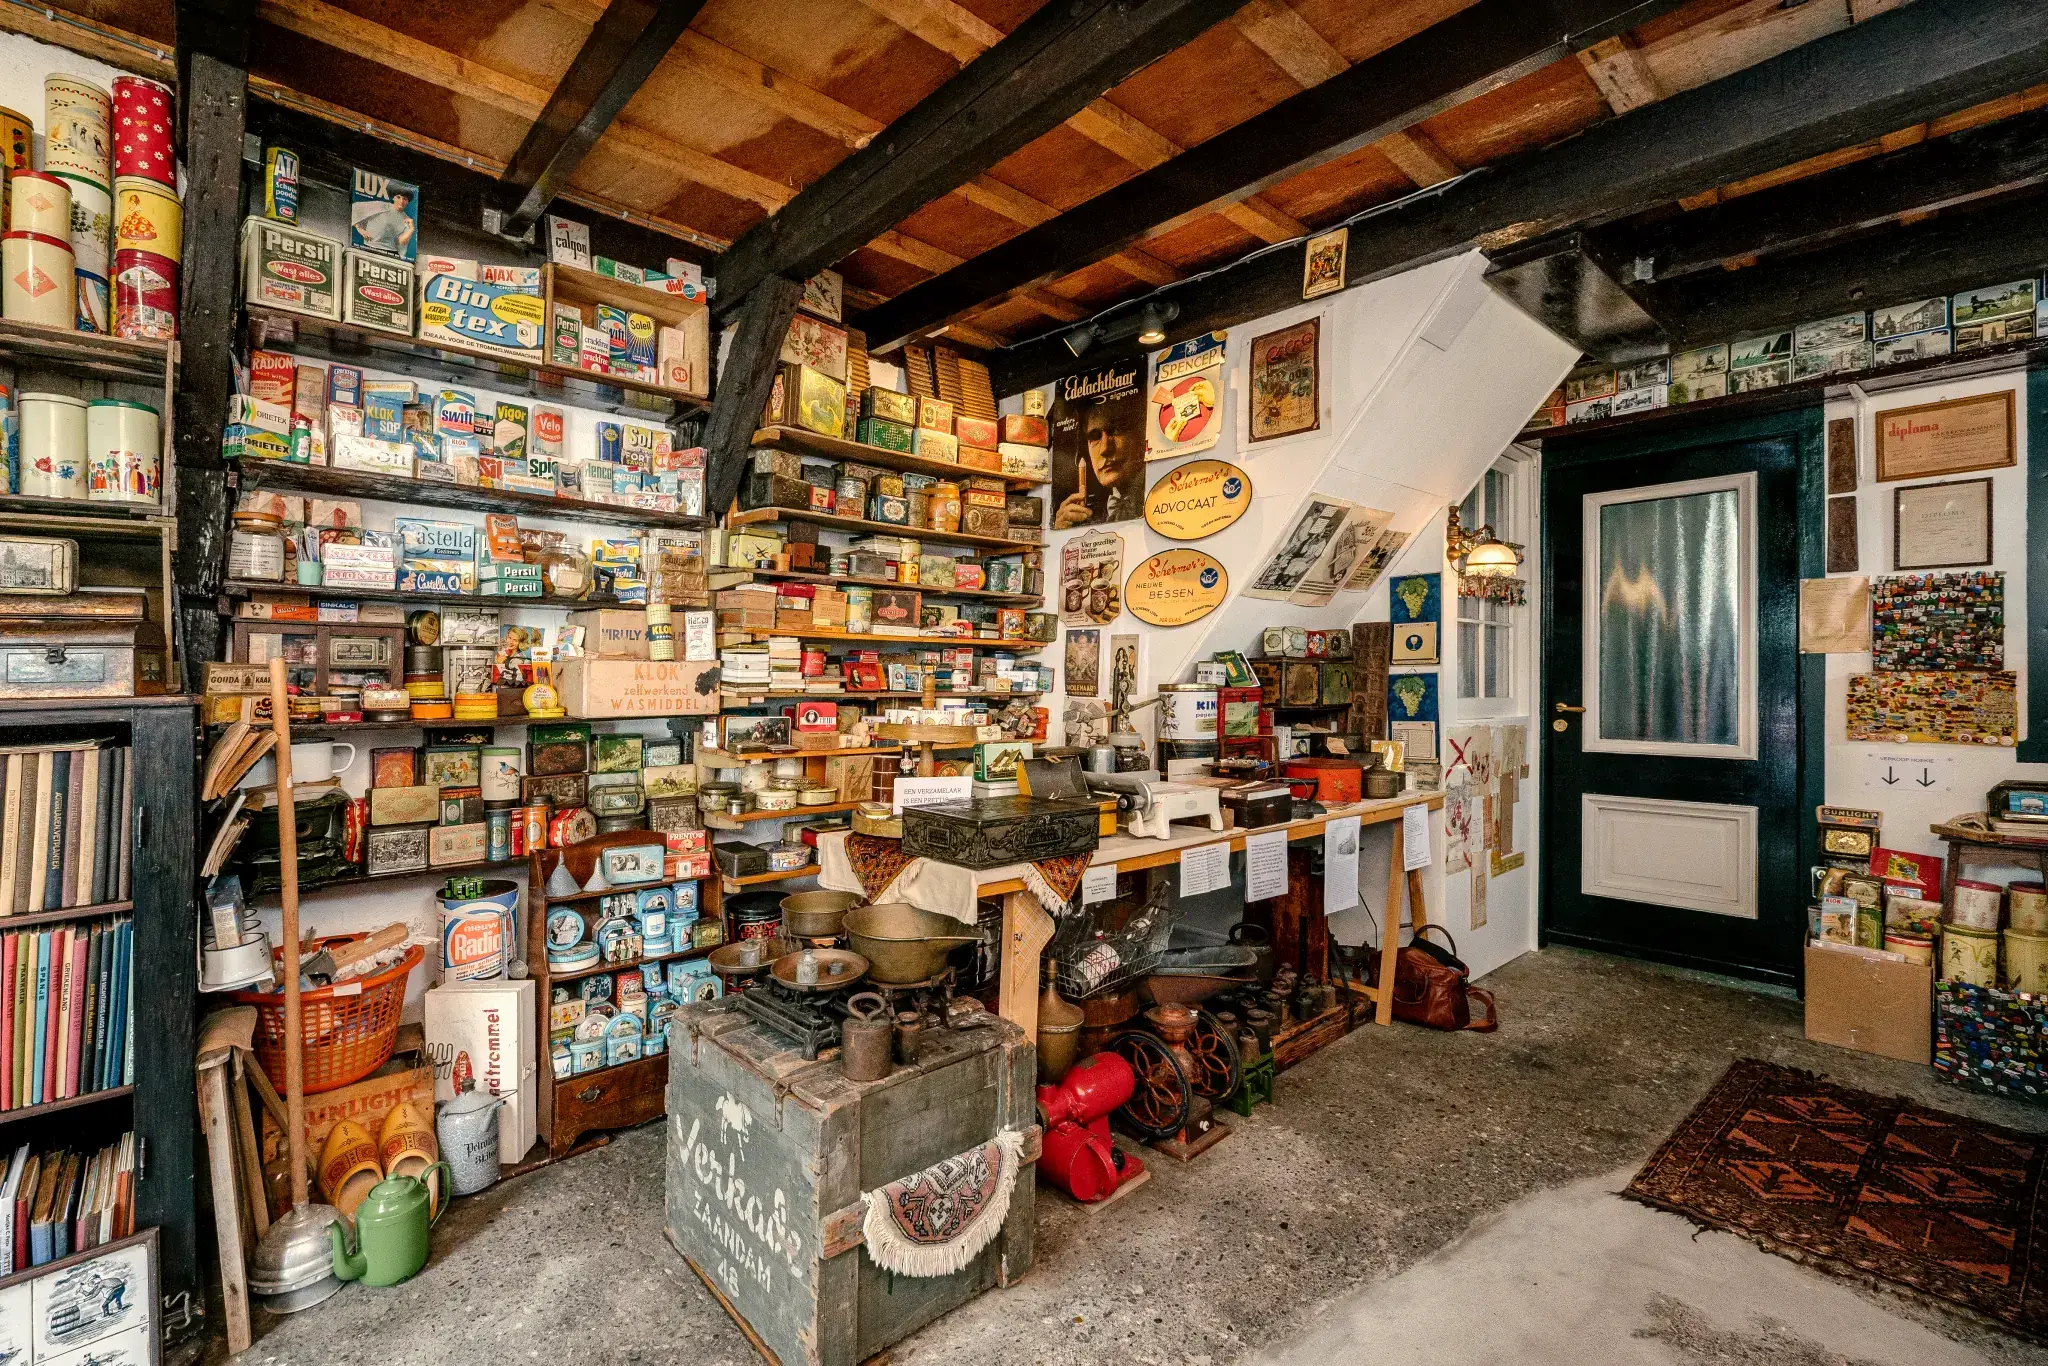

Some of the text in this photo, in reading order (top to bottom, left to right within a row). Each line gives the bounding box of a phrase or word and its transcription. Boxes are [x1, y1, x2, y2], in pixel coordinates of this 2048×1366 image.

[273, 153, 298, 181] ATA
[354, 168, 390, 200] LUX
[265, 230, 331, 262] Persil
[557, 231, 587, 259] calgon
[299, 270, 321, 281] alles
[358, 259, 407, 286] Persil
[484, 268, 514, 283] AJAX
[382, 293, 400, 303] alles
[436, 277, 490, 309] Bio
[453, 308, 508, 338] tex
[556, 317, 579, 333] Persil
[629, 319, 652, 331] Soleil
[423, 331, 447, 341] IDEAAL
[448, 336, 465, 345] VOOR
[475, 343, 541, 361] TROMMELWASMACHINE
[252, 357, 294, 371] RADION
[1064, 368, 1138, 402] Edelachtbaar
[1109, 387, 1139, 401] sigaren
[256, 410, 287, 425] DRIETEX
[366, 405, 395, 420] KLOK
[441, 405, 473, 425] swift
[496, 405, 526, 422] Vigor
[379, 421, 401, 433] SOP
[539, 415, 561, 432] Velo
[1888, 419, 1940, 441] diploma
[451, 438, 467, 447] KLOK
[630, 426, 654, 449] Sol
[244, 437, 290, 455] DRIETEX
[625, 451, 653, 463] FORT
[1168, 467, 1230, 494] Schermer's
[1152, 495, 1218, 515] ADVOCAAT
[1920, 509, 1966, 519] DIPLOMA
[1092, 538, 1117, 547] gezellige
[504, 567, 536, 577] Persil
[1147, 557, 1207, 580] Schermer's
[417, 575, 448, 592] Castella
[505, 582, 537, 594] Persil
[1135, 581, 1163, 589] NIEUWE
[1148, 588, 1195, 600] BESSEN
[634, 662, 681, 681] KLOK
[210, 676, 240, 684] GOUDA
[624, 685, 689, 697] zelfwerkend
[610, 699, 699, 711] WASMIDDEL
[1196, 700, 1217, 711] KIN
[917, 787, 962, 795] VERZAMELAAR
[1823, 809, 1876, 819] SUNLIGHT
[463, 921, 499, 933] nieuw
[19, 963, 27, 1006] FRANKRIJK
[38, 966, 47, 1001] SPANJE
[61, 962, 71, 1012] GRIEKENLAND
[75, 975, 83, 989] DER
[74, 990, 83, 1019] VADEREN
[303, 1083, 417, 1126] UNLIGHT
[693, 1190, 771, 1294] ZAANDAM
